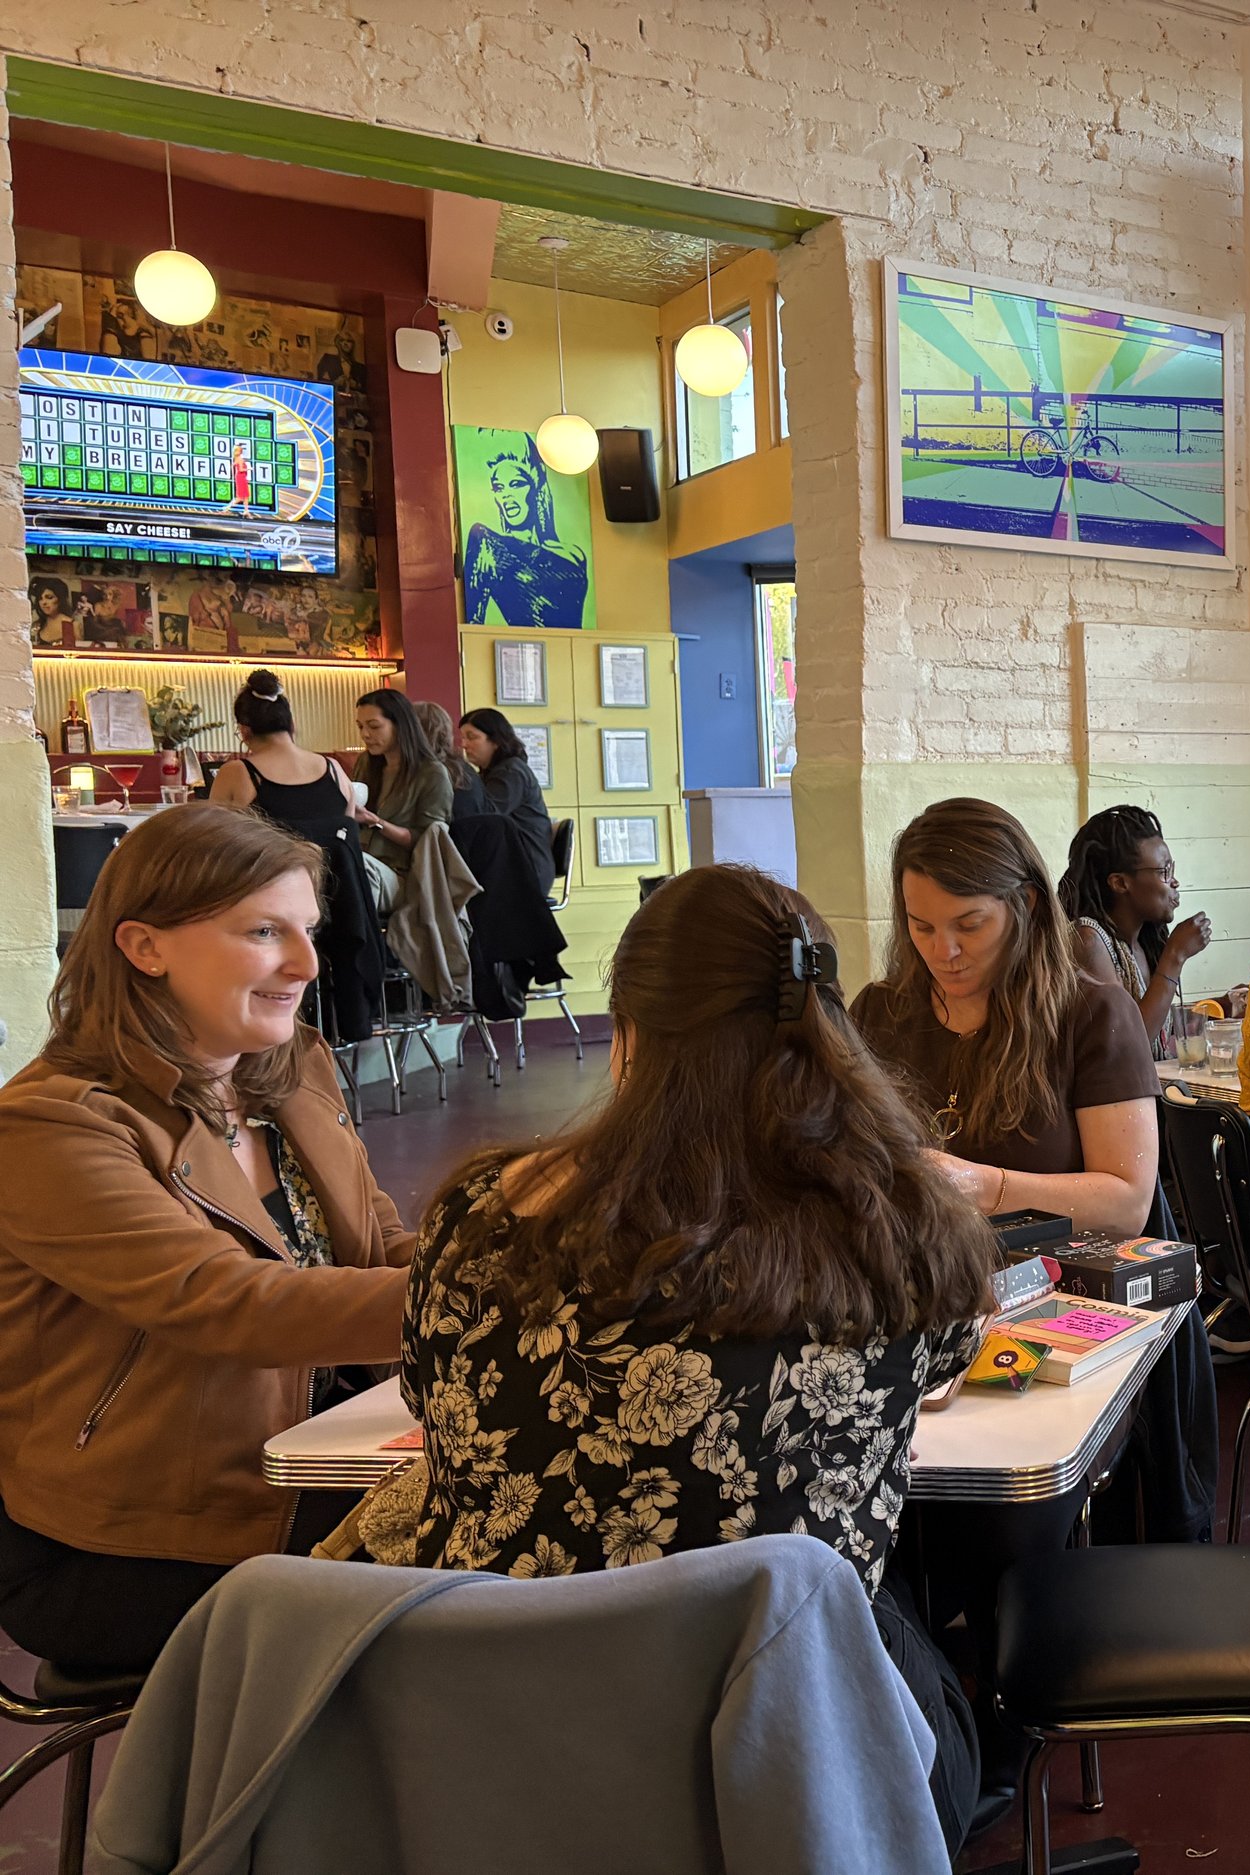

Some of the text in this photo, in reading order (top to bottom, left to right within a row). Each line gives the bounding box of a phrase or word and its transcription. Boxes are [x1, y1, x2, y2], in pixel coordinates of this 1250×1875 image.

[89, 428, 185, 450] TURES
[90, 450, 269, 479] BREAKFAT
[106, 522, 191, 539] SAY CHEESE!
[262, 536, 280, 545] abc
[1066, 1298, 1150, 1321] Cosmic
[998, 1355, 1012, 1364] 8
